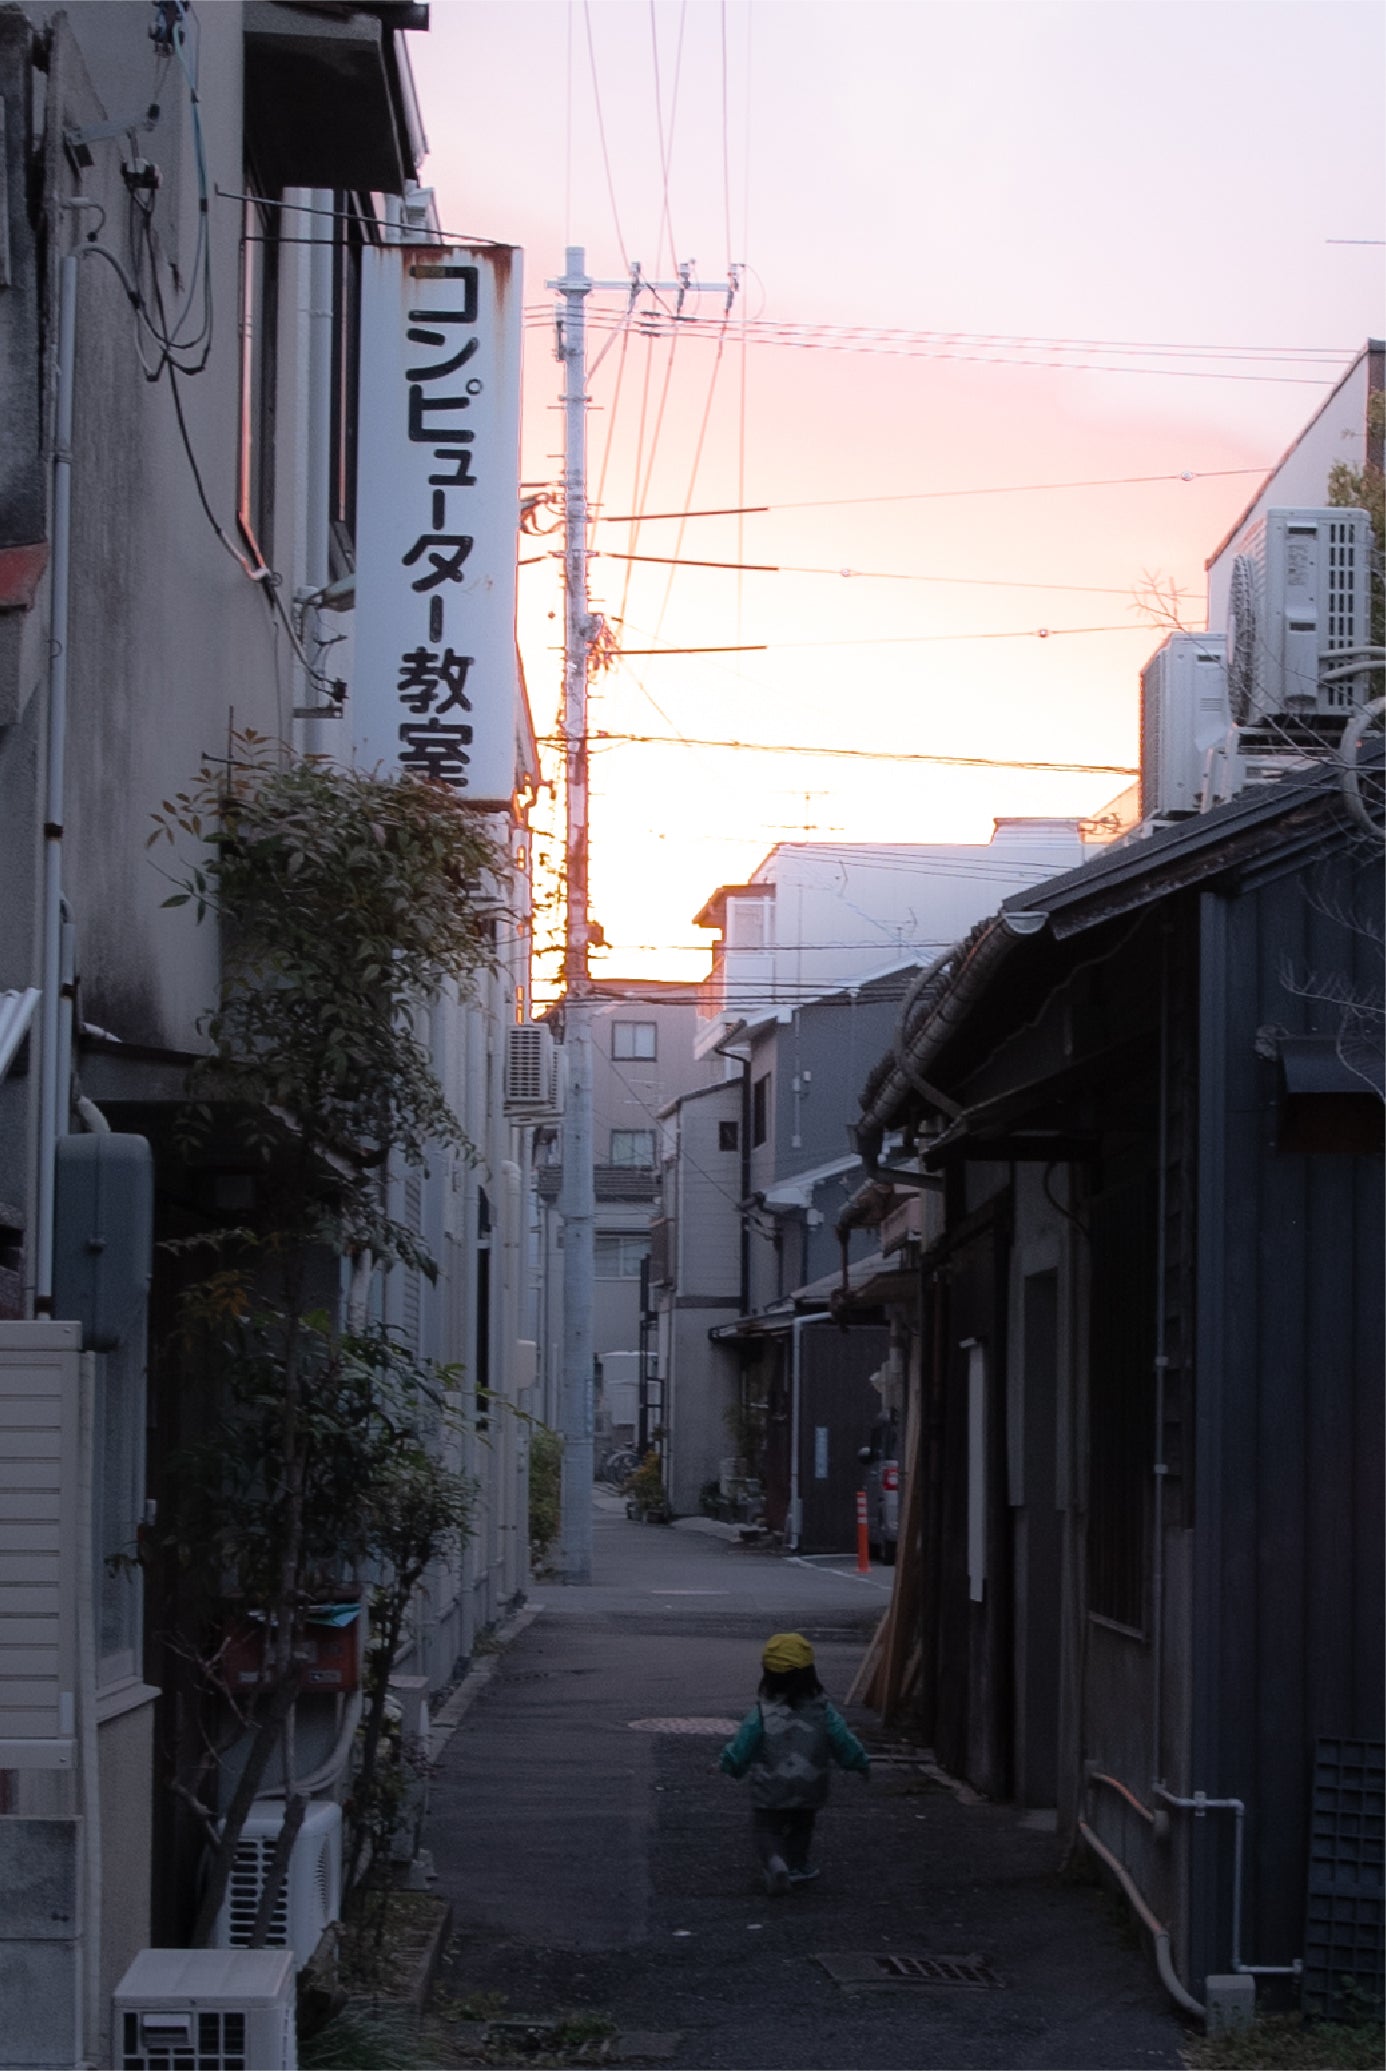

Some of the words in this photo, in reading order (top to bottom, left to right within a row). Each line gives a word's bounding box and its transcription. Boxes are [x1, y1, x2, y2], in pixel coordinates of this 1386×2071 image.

[397, 265, 484, 788] コンピューター教室
